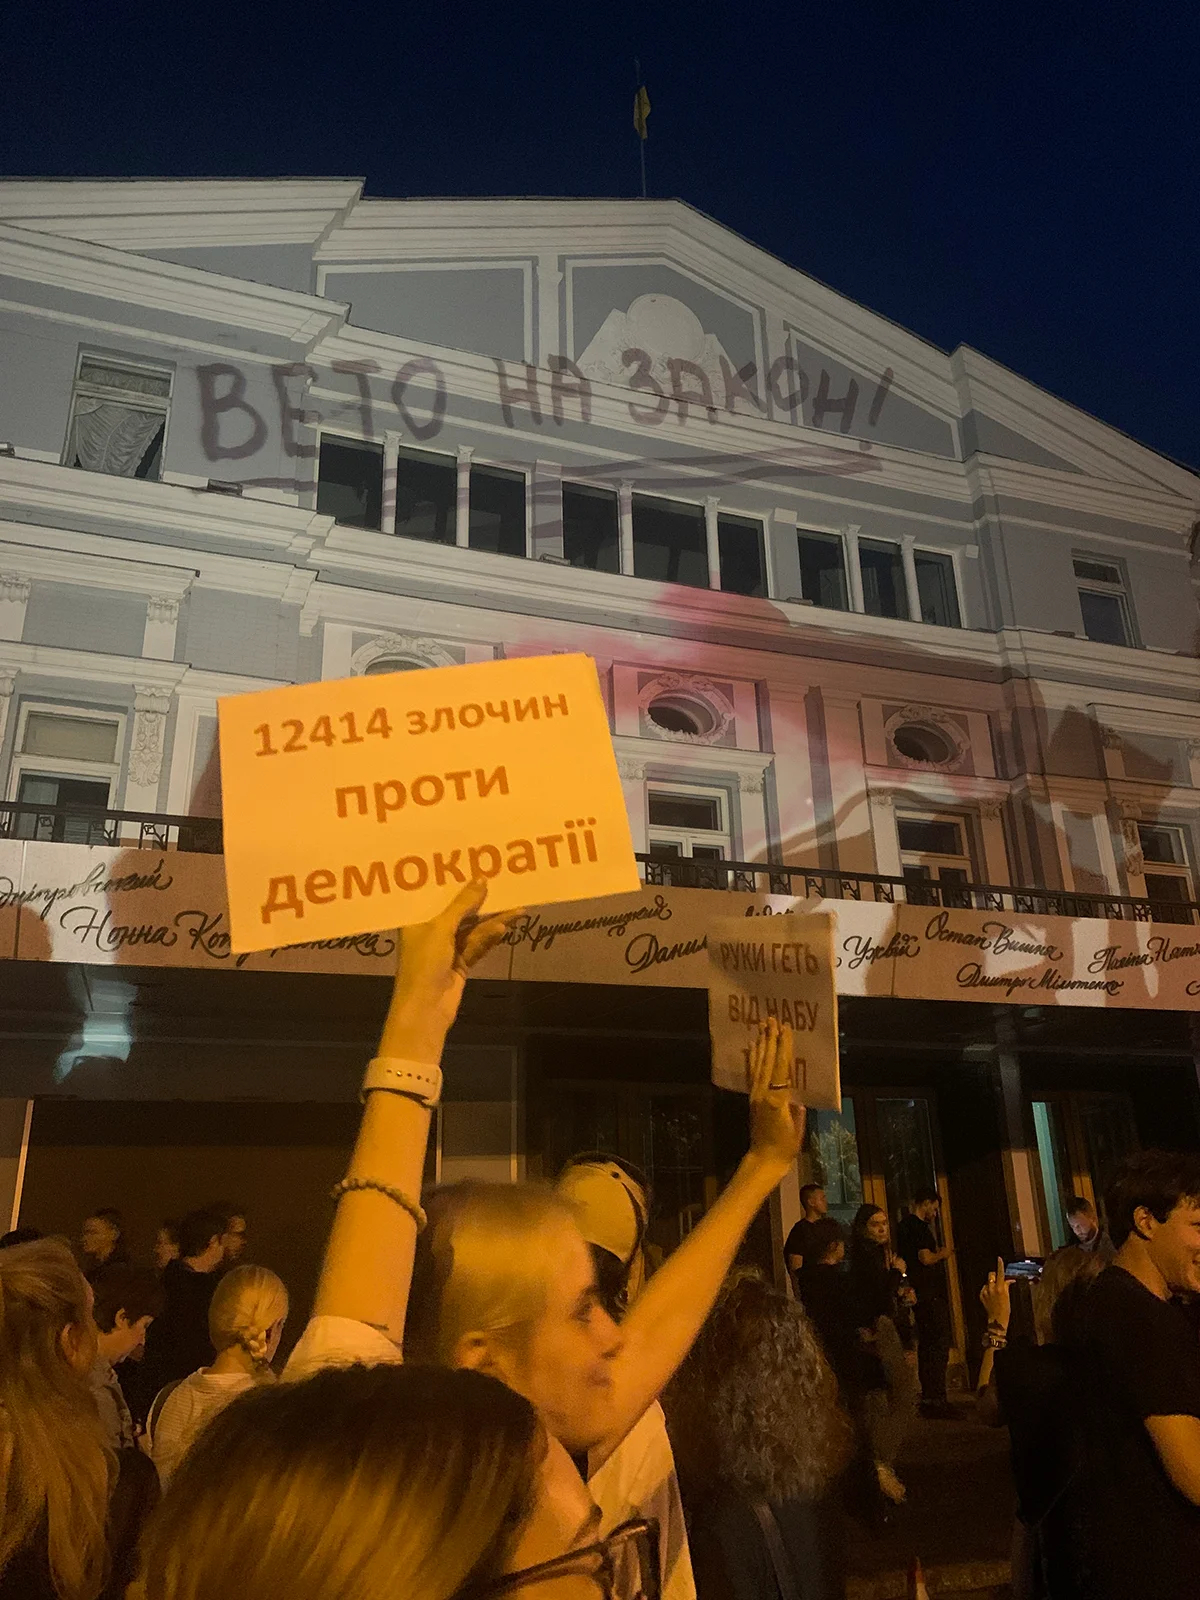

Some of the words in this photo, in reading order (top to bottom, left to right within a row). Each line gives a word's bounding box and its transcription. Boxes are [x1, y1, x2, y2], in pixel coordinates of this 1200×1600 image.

[197, 358, 447, 461] ВЕТО
[499, 353, 593, 429] НА
[621, 345, 893, 450] ЗАКОН!
[253, 707, 393, 757] 12414
[406, 693, 570, 736] злочин
[335, 765, 510, 823] проти
[260, 816, 599, 925] демократії
[59, 906, 177, 954] Нонна
[842, 932, 921, 970] Ужвій
[925, 912, 992, 951] Остап
[982, 921, 1063, 962] Вишня
[720, 942, 766, 972] РУКИ
[771, 942, 820, 976] ГЕТЬ
[956, 961, 1031, 997] Дмитро
[1087, 945, 1154, 974] Поліна
[728, 993, 761, 1025] ВІД
[765, 998, 819, 1032] НАБУ
